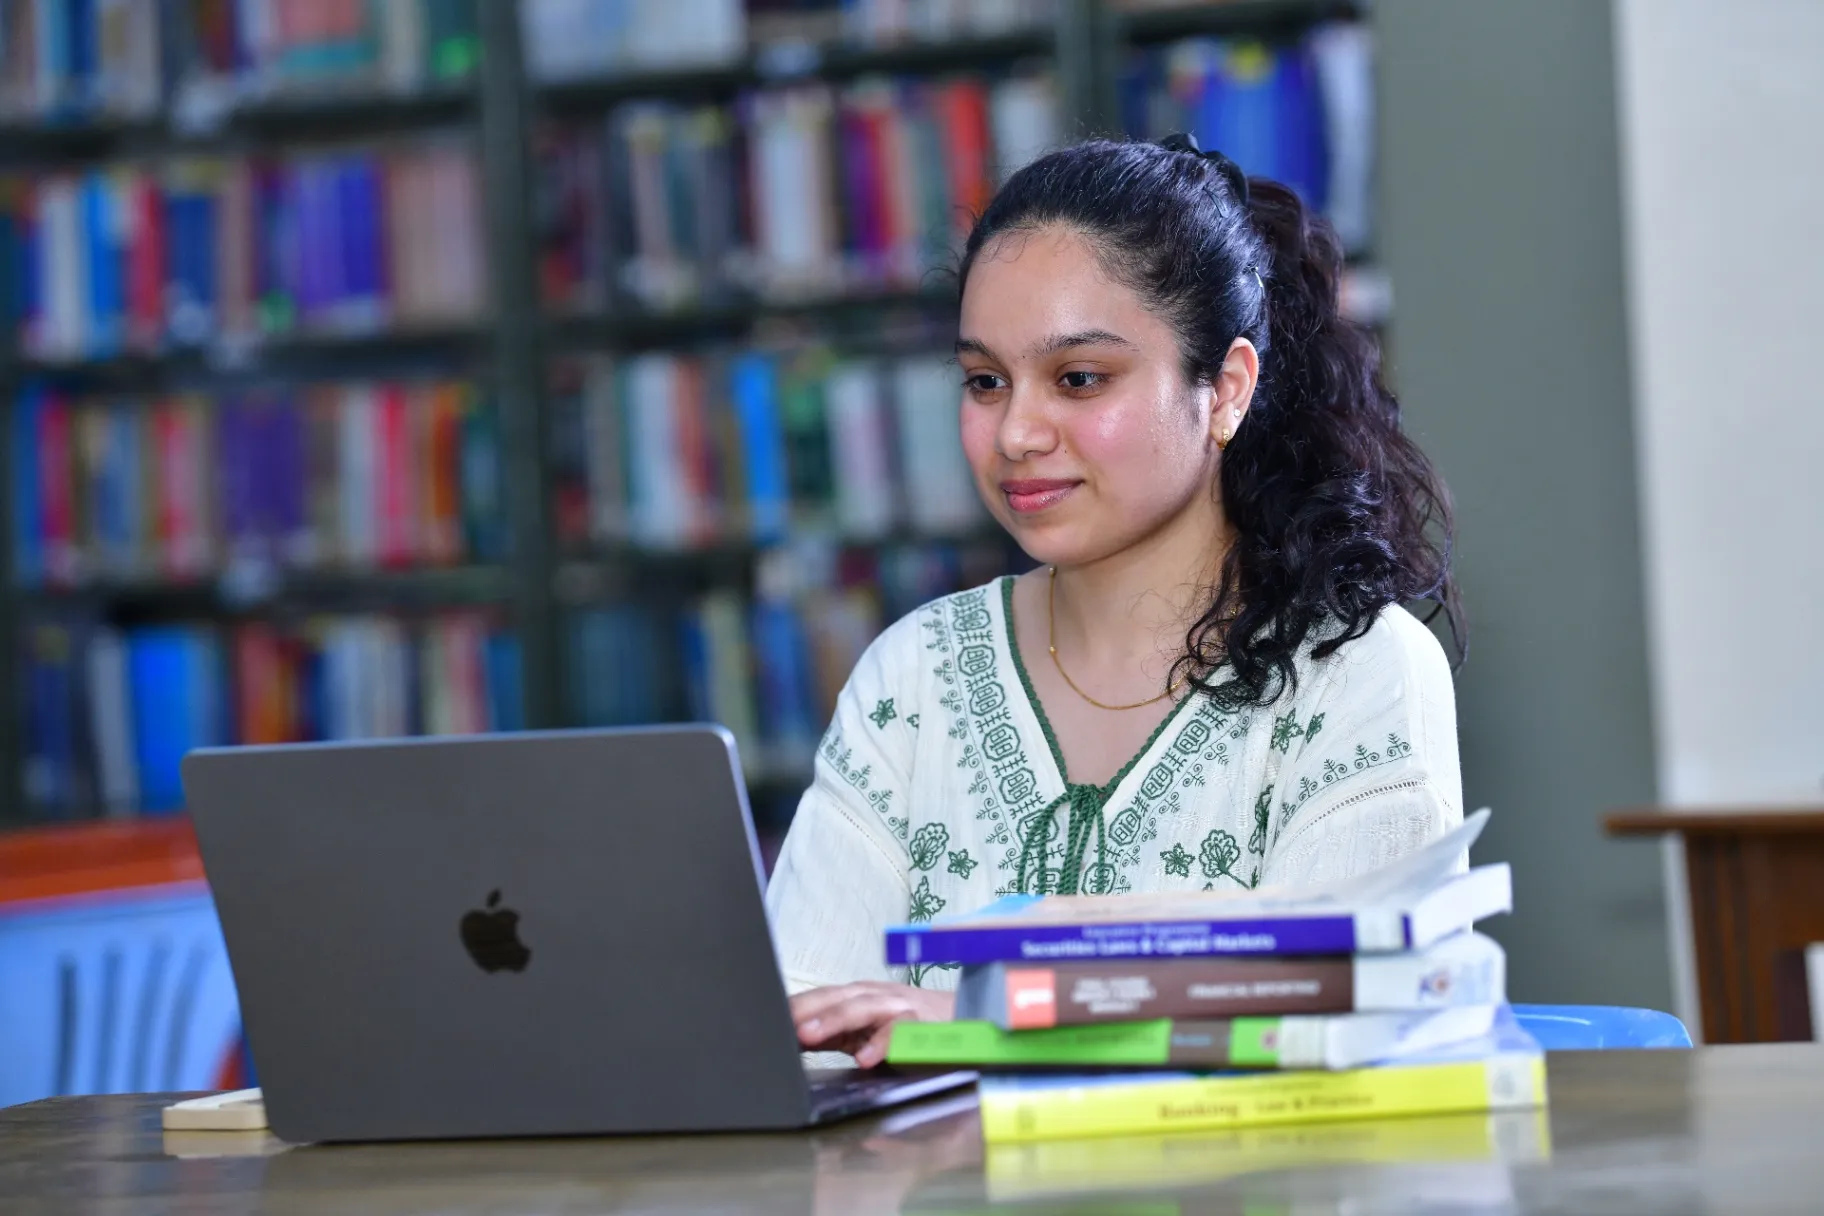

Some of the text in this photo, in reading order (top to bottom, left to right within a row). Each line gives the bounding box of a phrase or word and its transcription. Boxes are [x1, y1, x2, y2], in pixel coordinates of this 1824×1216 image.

[1022, 940, 1097, 957] Securities
[1099, 939, 1138, 955] Laws
[1154, 935, 1211, 955] Capital
[1213, 933, 1276, 950] Markets
[1158, 1102, 1238, 1121] Banking
